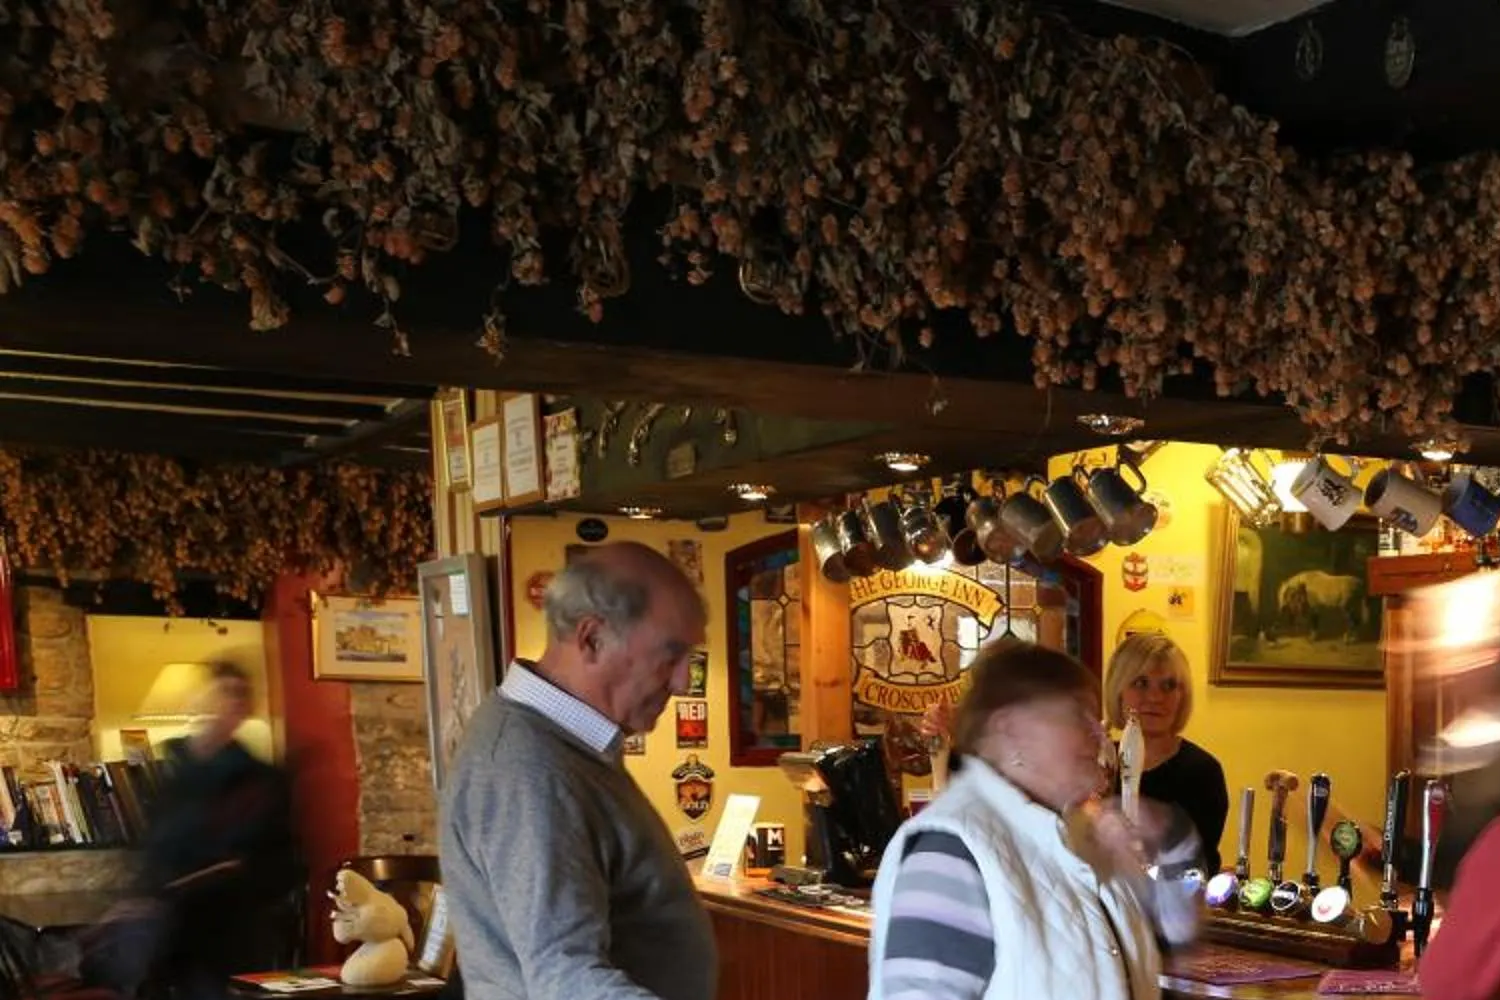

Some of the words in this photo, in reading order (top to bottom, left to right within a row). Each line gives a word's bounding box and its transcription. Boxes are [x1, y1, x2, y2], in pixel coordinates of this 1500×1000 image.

[851, 577, 878, 599] HE
[879, 572, 949, 593] GEORGE
[953, 580, 987, 607] INN
